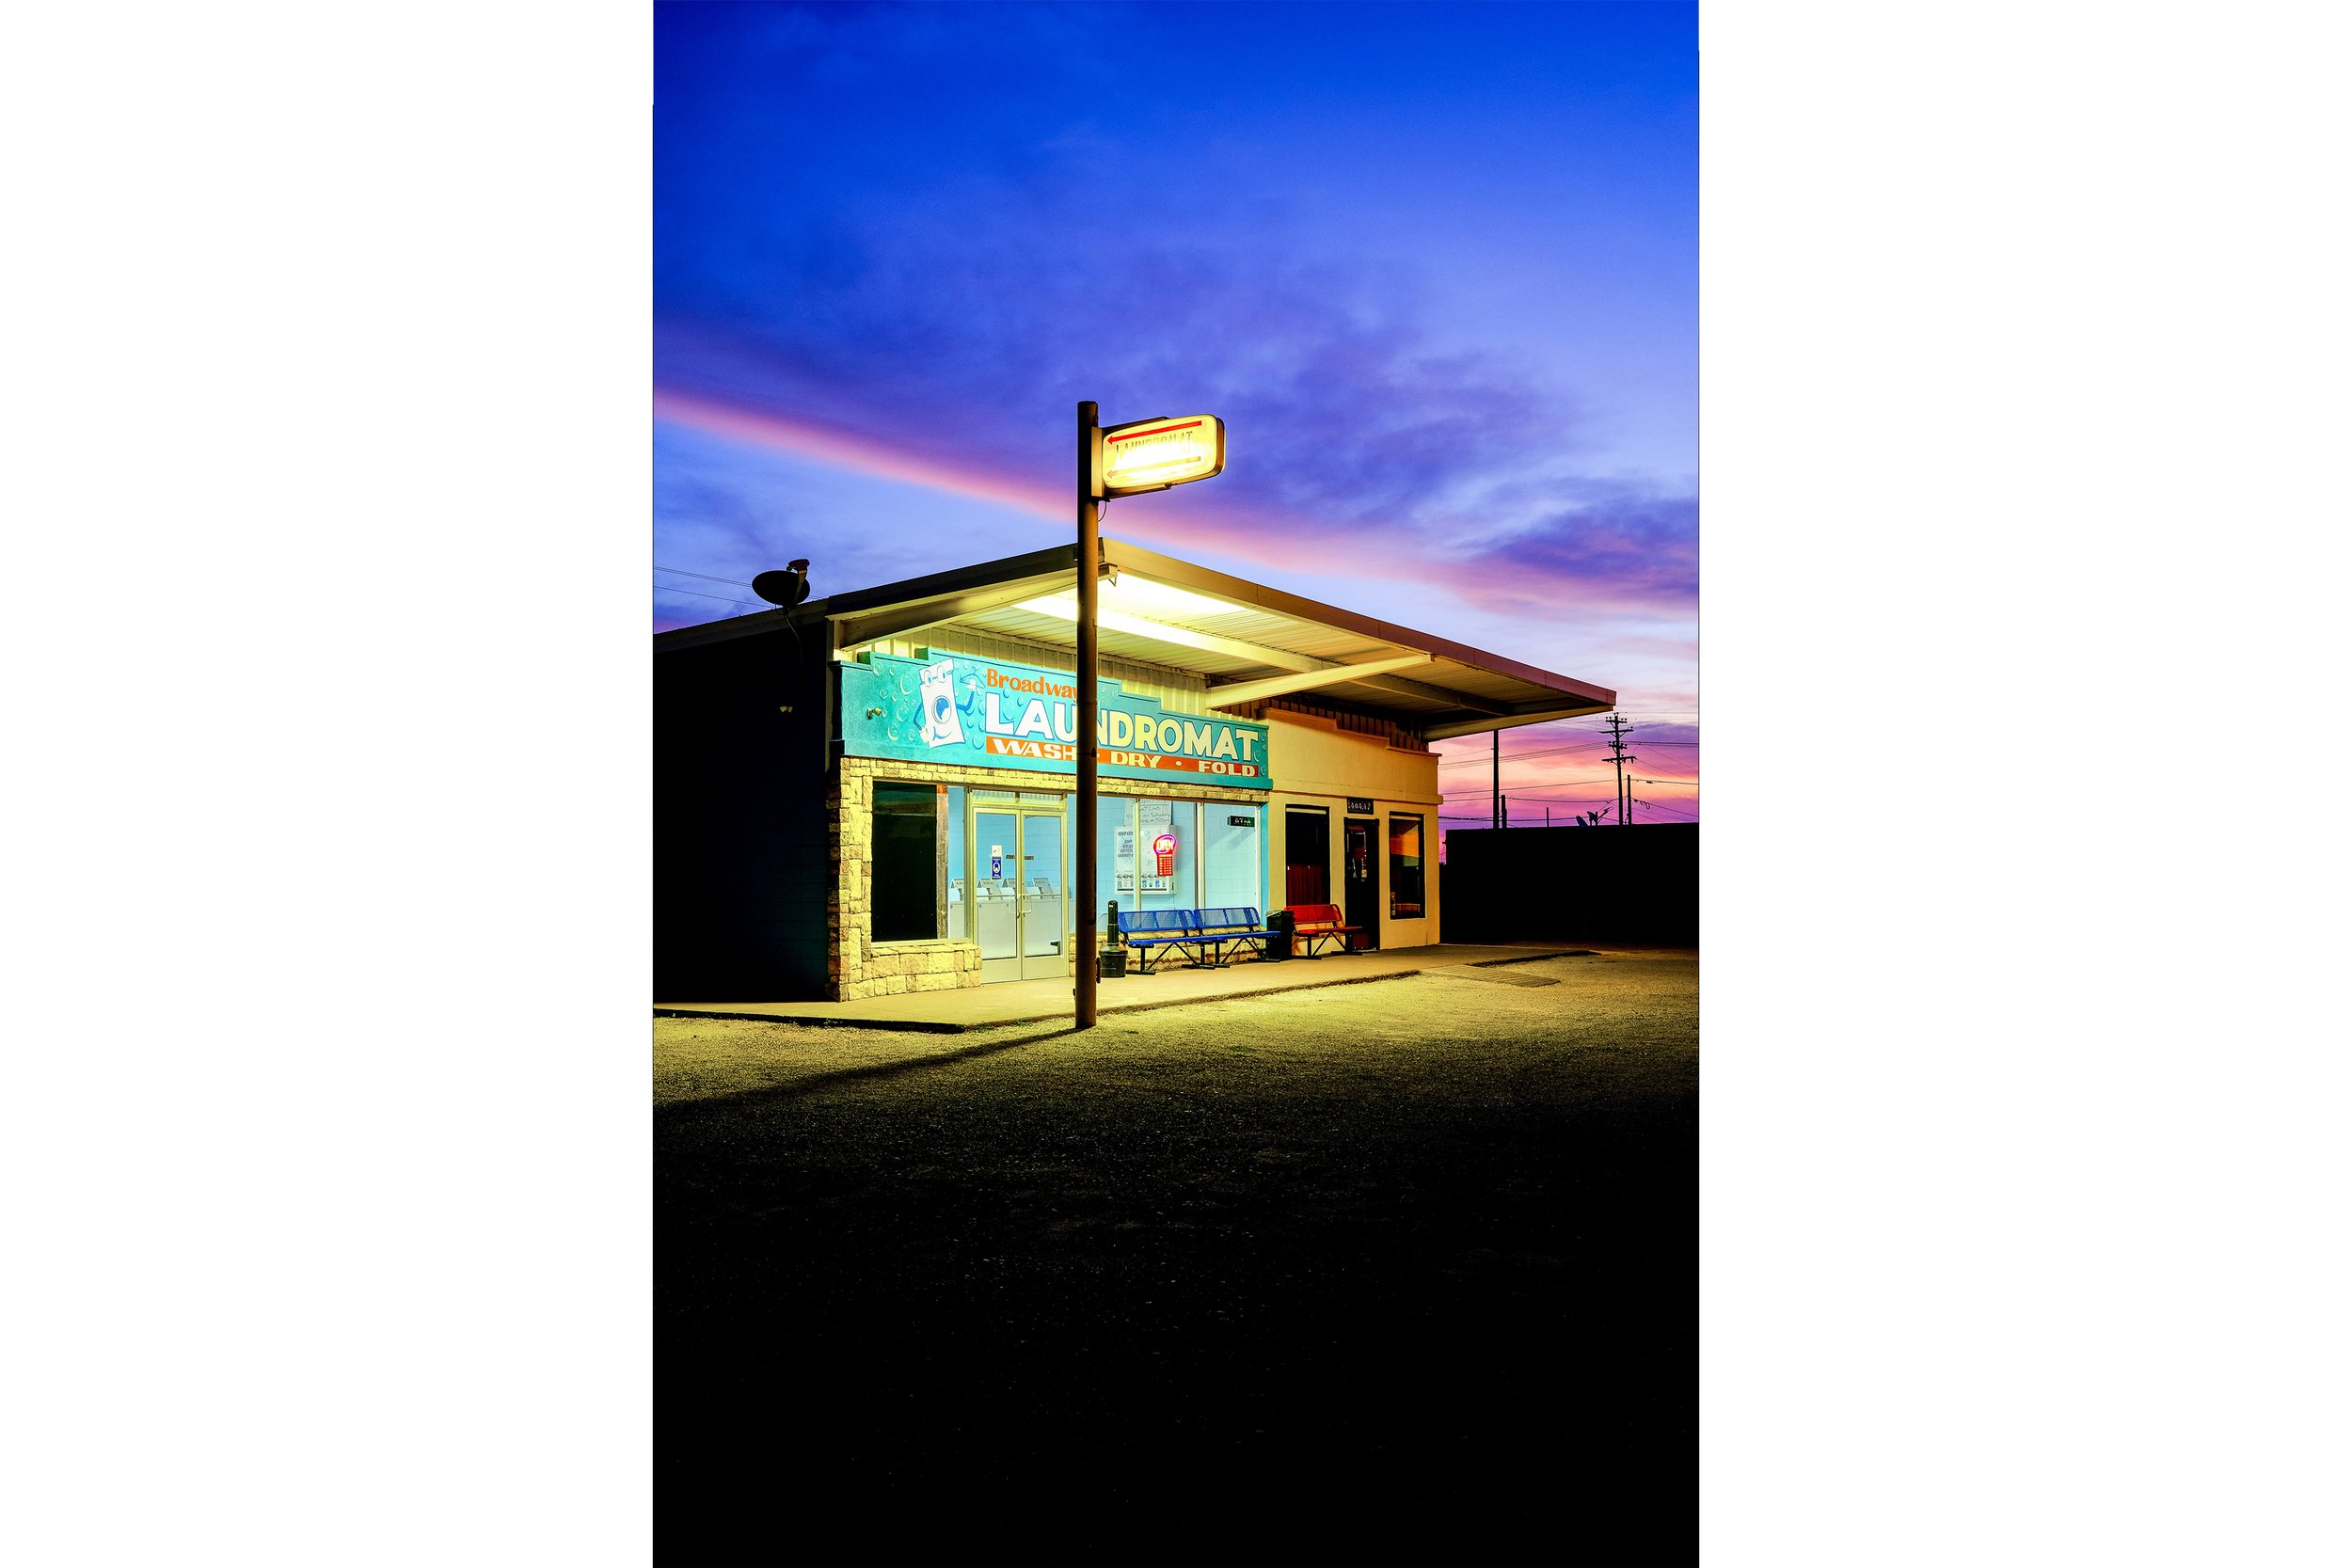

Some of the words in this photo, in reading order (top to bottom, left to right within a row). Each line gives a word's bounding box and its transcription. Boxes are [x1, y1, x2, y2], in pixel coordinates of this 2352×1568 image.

[993, 738, 1076, 761] WASH
[1110, 751, 1162, 768] DRY
[1199, 760, 1255, 777] FOLD
[1156, 839, 1173, 851] OPEN
